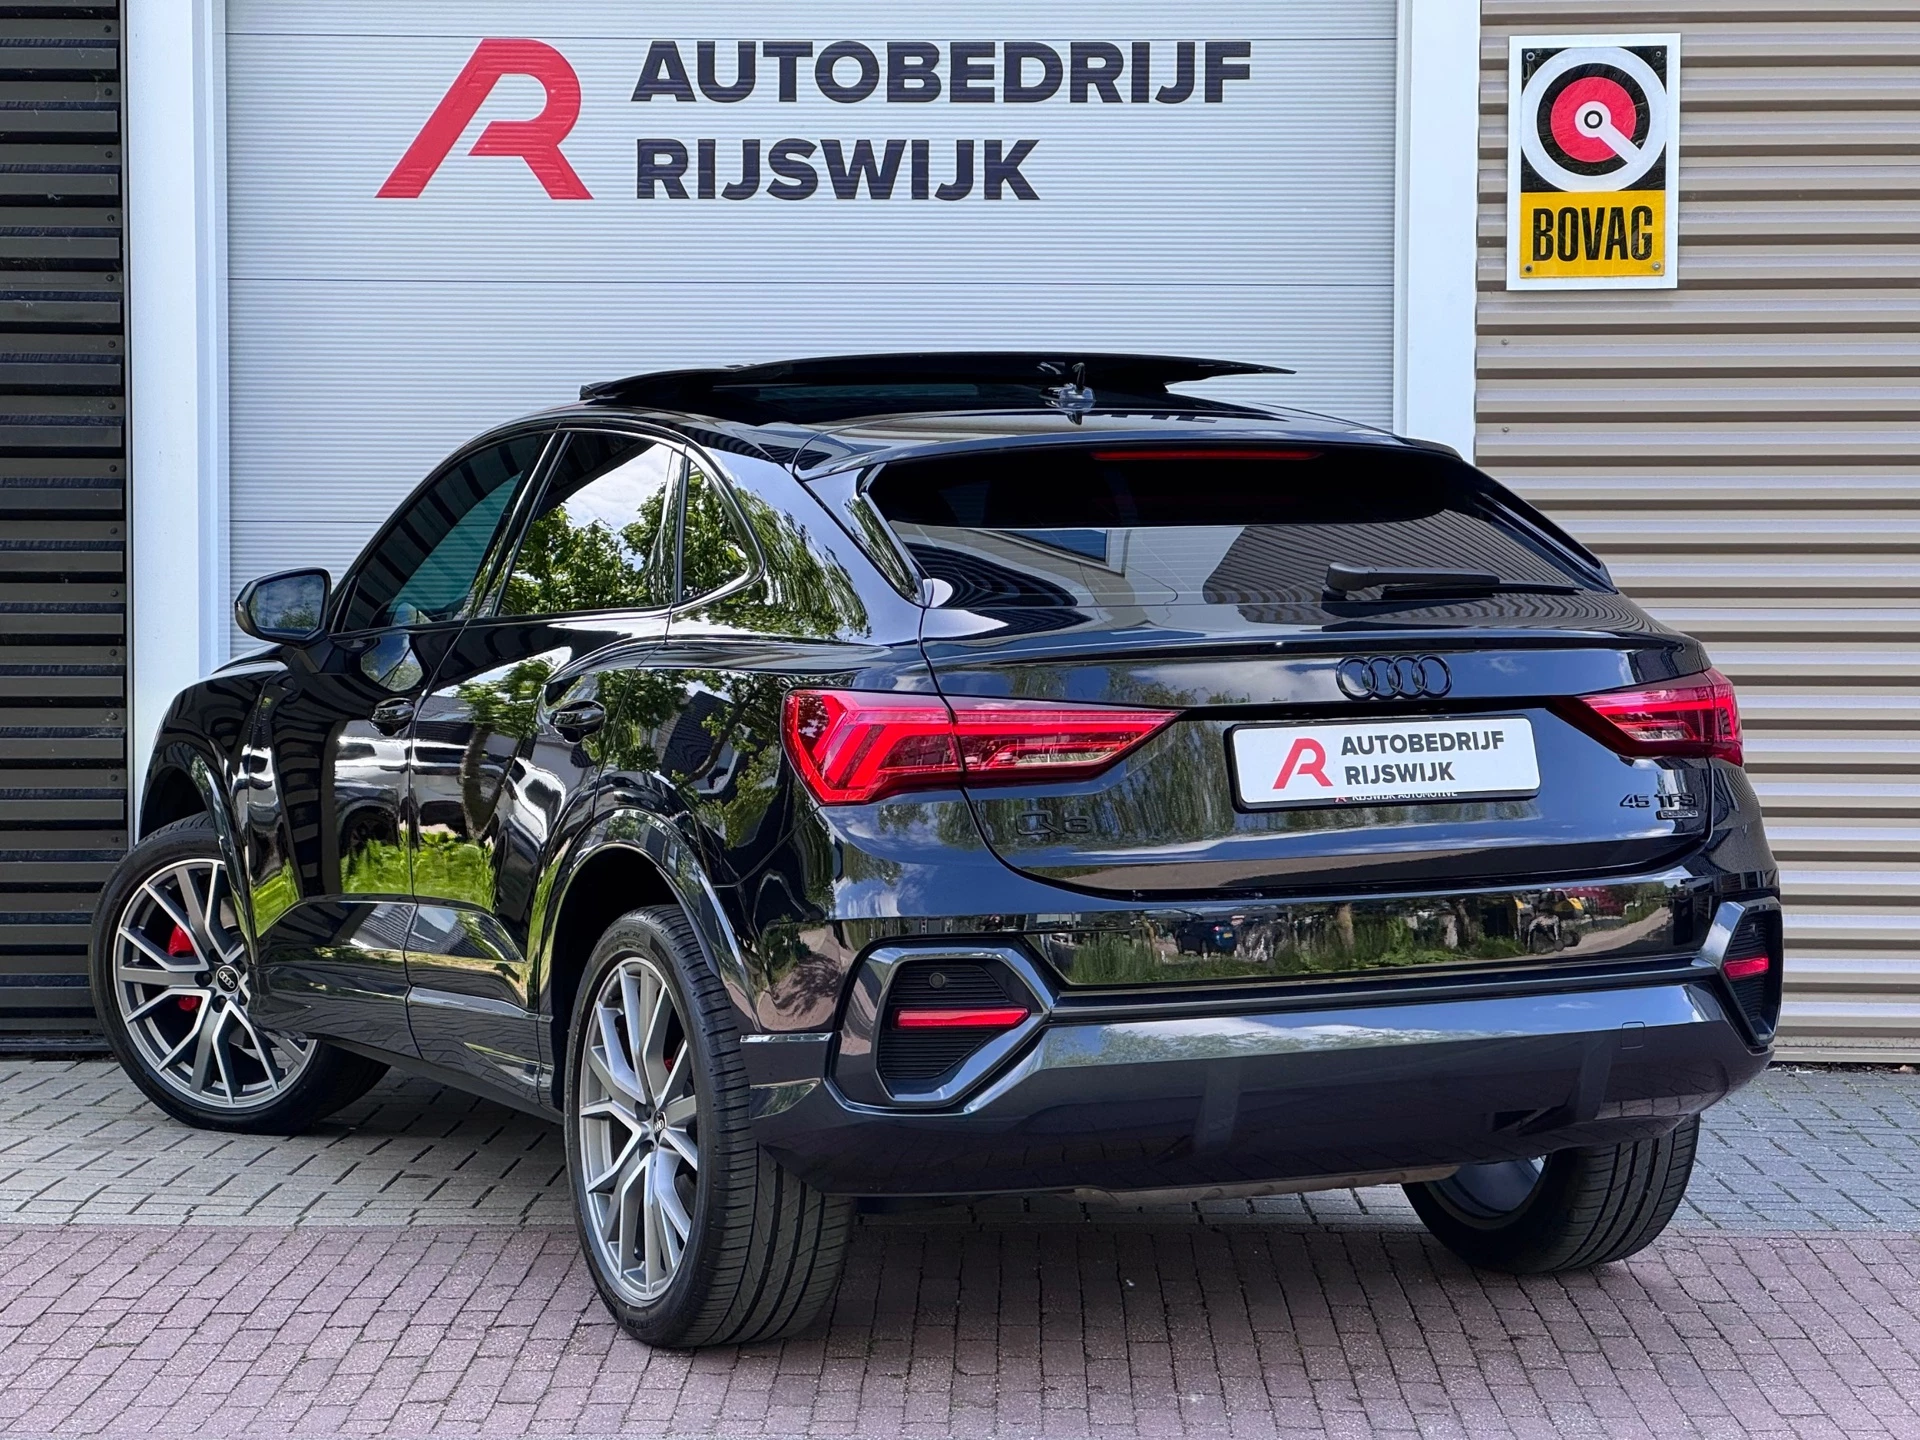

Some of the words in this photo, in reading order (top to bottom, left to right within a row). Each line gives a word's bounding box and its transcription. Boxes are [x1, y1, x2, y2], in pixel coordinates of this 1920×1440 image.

[630, 40, 1252, 104] AUTOBEDRIJF
[636, 138, 1041, 201] RIJSWIJK
[1532, 205, 1653, 262] BOVAG
[1341, 730, 1505, 756] AUTOBEDRIJF
[1344, 761, 1456, 786] RIJSWIJK
[1619, 793, 1651, 809] 45
[1653, 792, 1699, 809] TFSI
[1016, 810, 1092, 836] Q3
